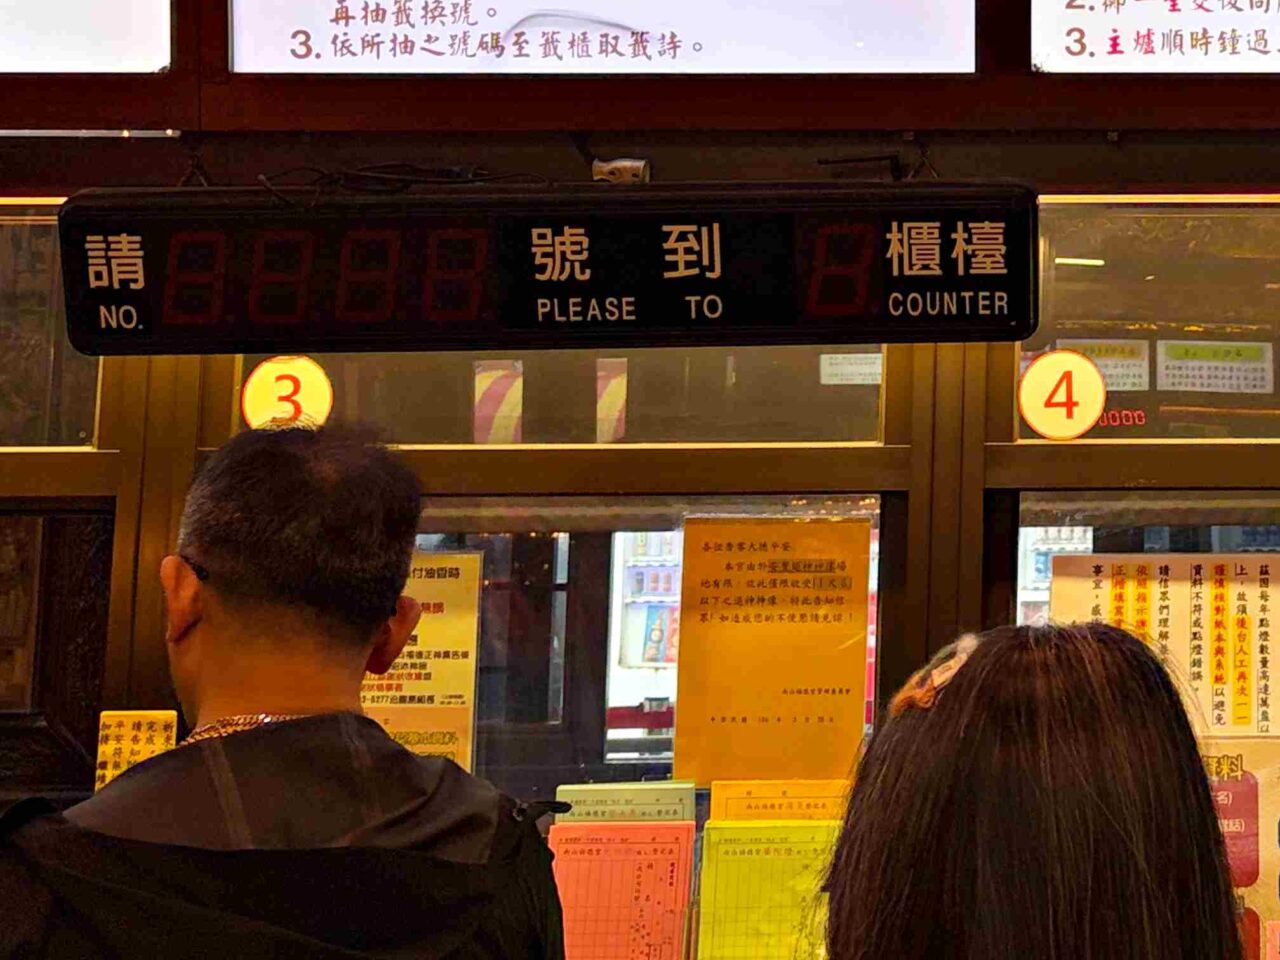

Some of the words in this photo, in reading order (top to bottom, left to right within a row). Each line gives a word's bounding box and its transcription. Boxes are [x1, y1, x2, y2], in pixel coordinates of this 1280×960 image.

[84, 231, 146, 292] 請
[530, 225, 592, 283] 號
[661, 222, 723, 281] 到
[884, 219, 1009, 278] 櫃檯
[99, 305, 145, 331] NO.
[536, 296, 637, 323] PLEASE
[686, 295, 724, 321] TO
[886, 290, 1011, 318] COUNTER
[274, 374, 303, 426] 3
[1043, 370, 1080, 420] 4
